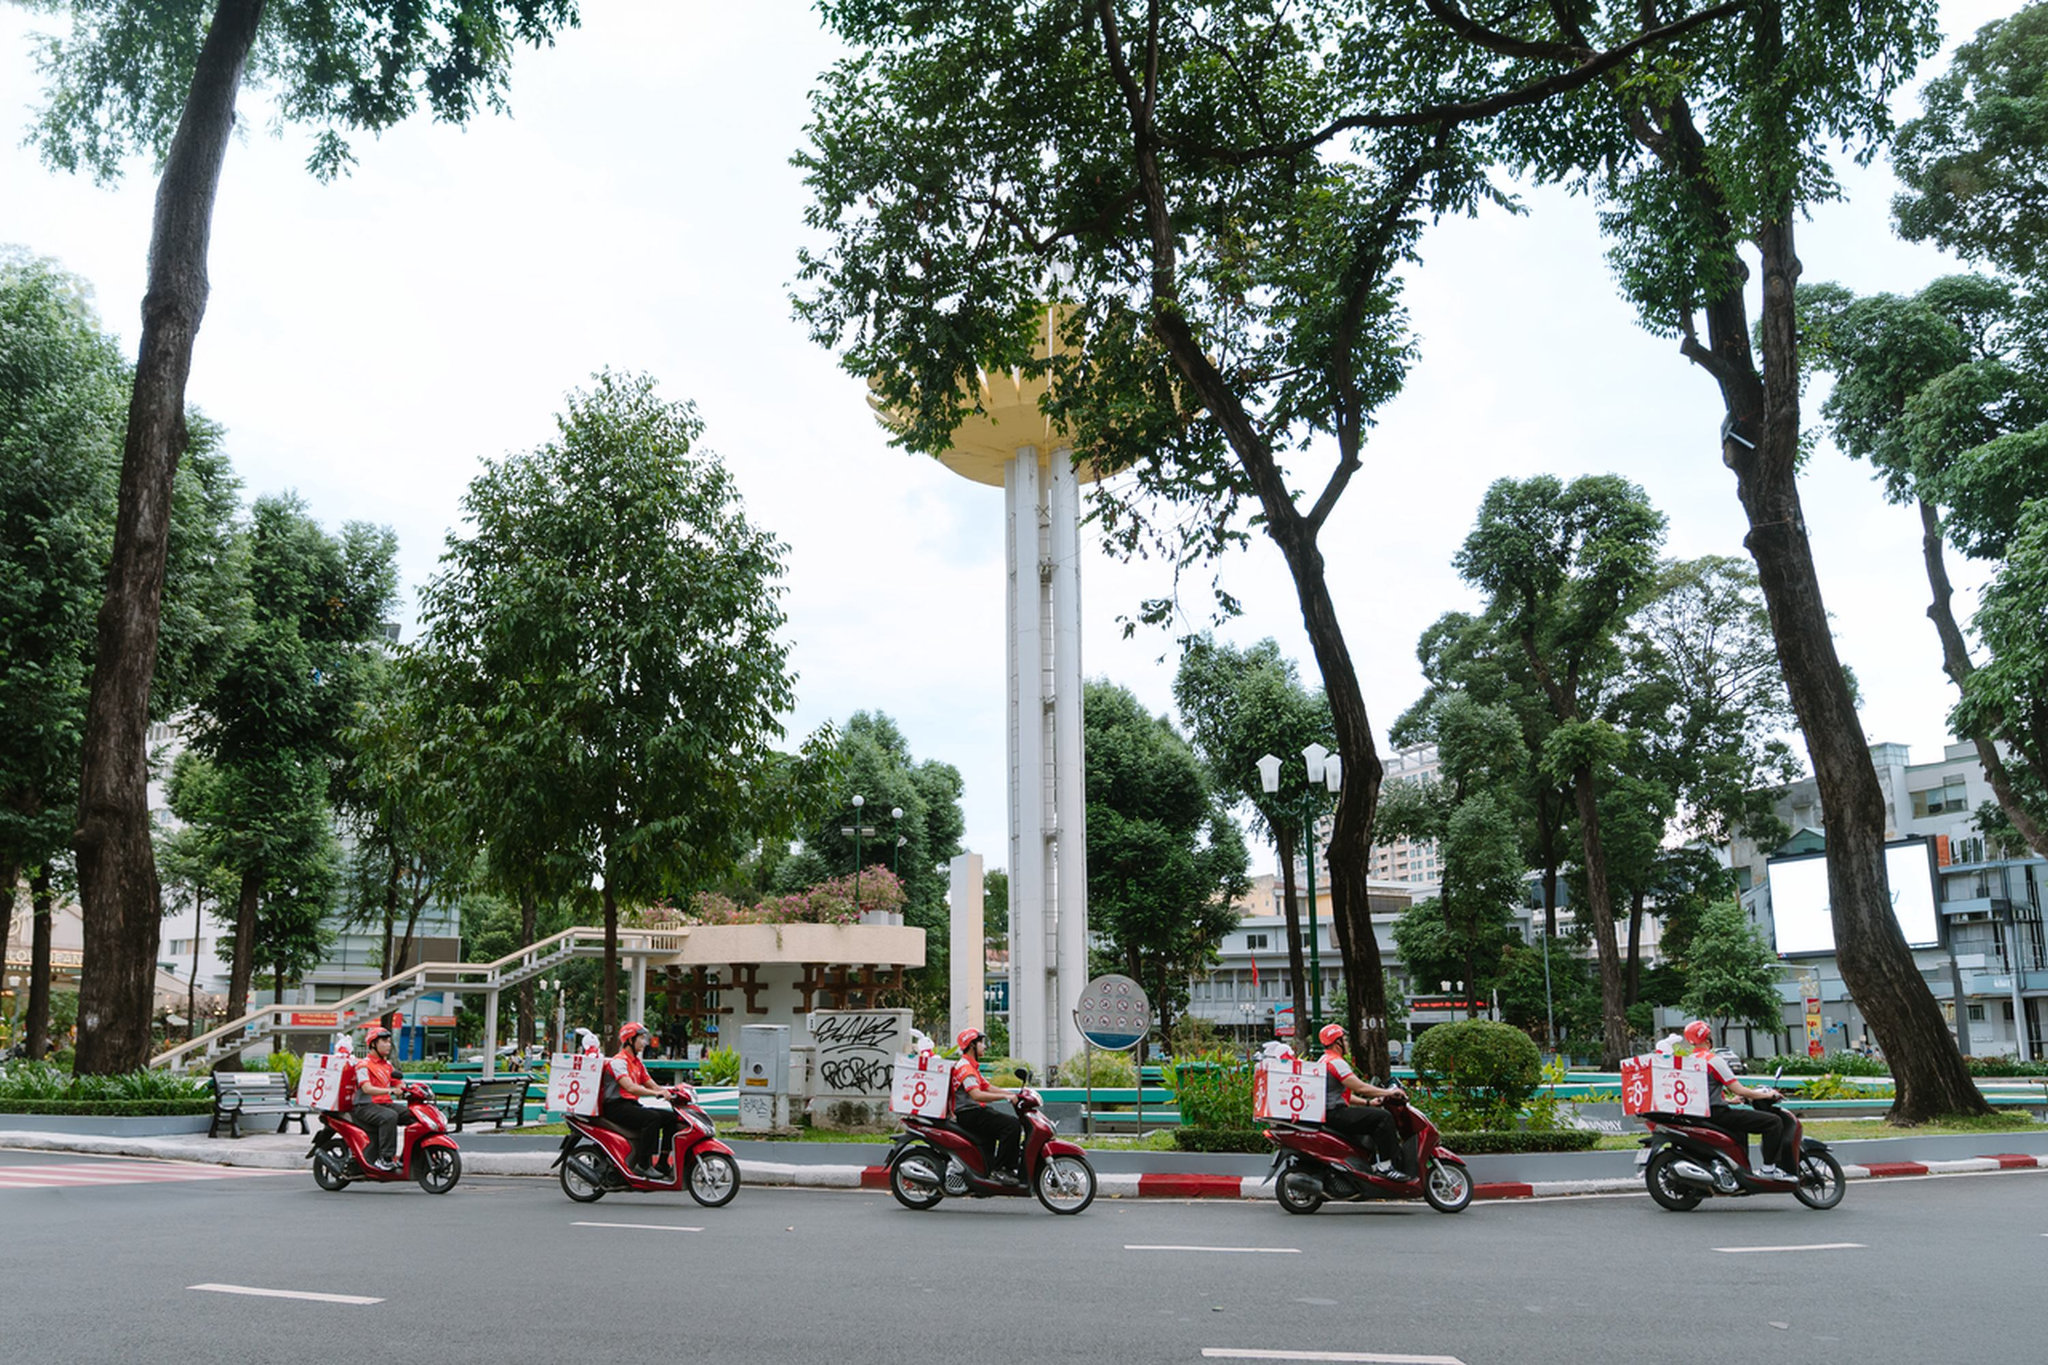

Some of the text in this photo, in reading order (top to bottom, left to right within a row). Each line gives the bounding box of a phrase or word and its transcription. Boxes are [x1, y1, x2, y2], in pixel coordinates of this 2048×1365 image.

[1361, 1017, 1385, 1030] 101
[313, 1078, 325, 1101] 8
[566, 1080, 580, 1106] 8
[912, 1081, 927, 1108] 8
[1290, 1085, 1305, 1112] 8
[1633, 1080, 1643, 1107] 8
[1673, 1080, 1688, 1106] 8
